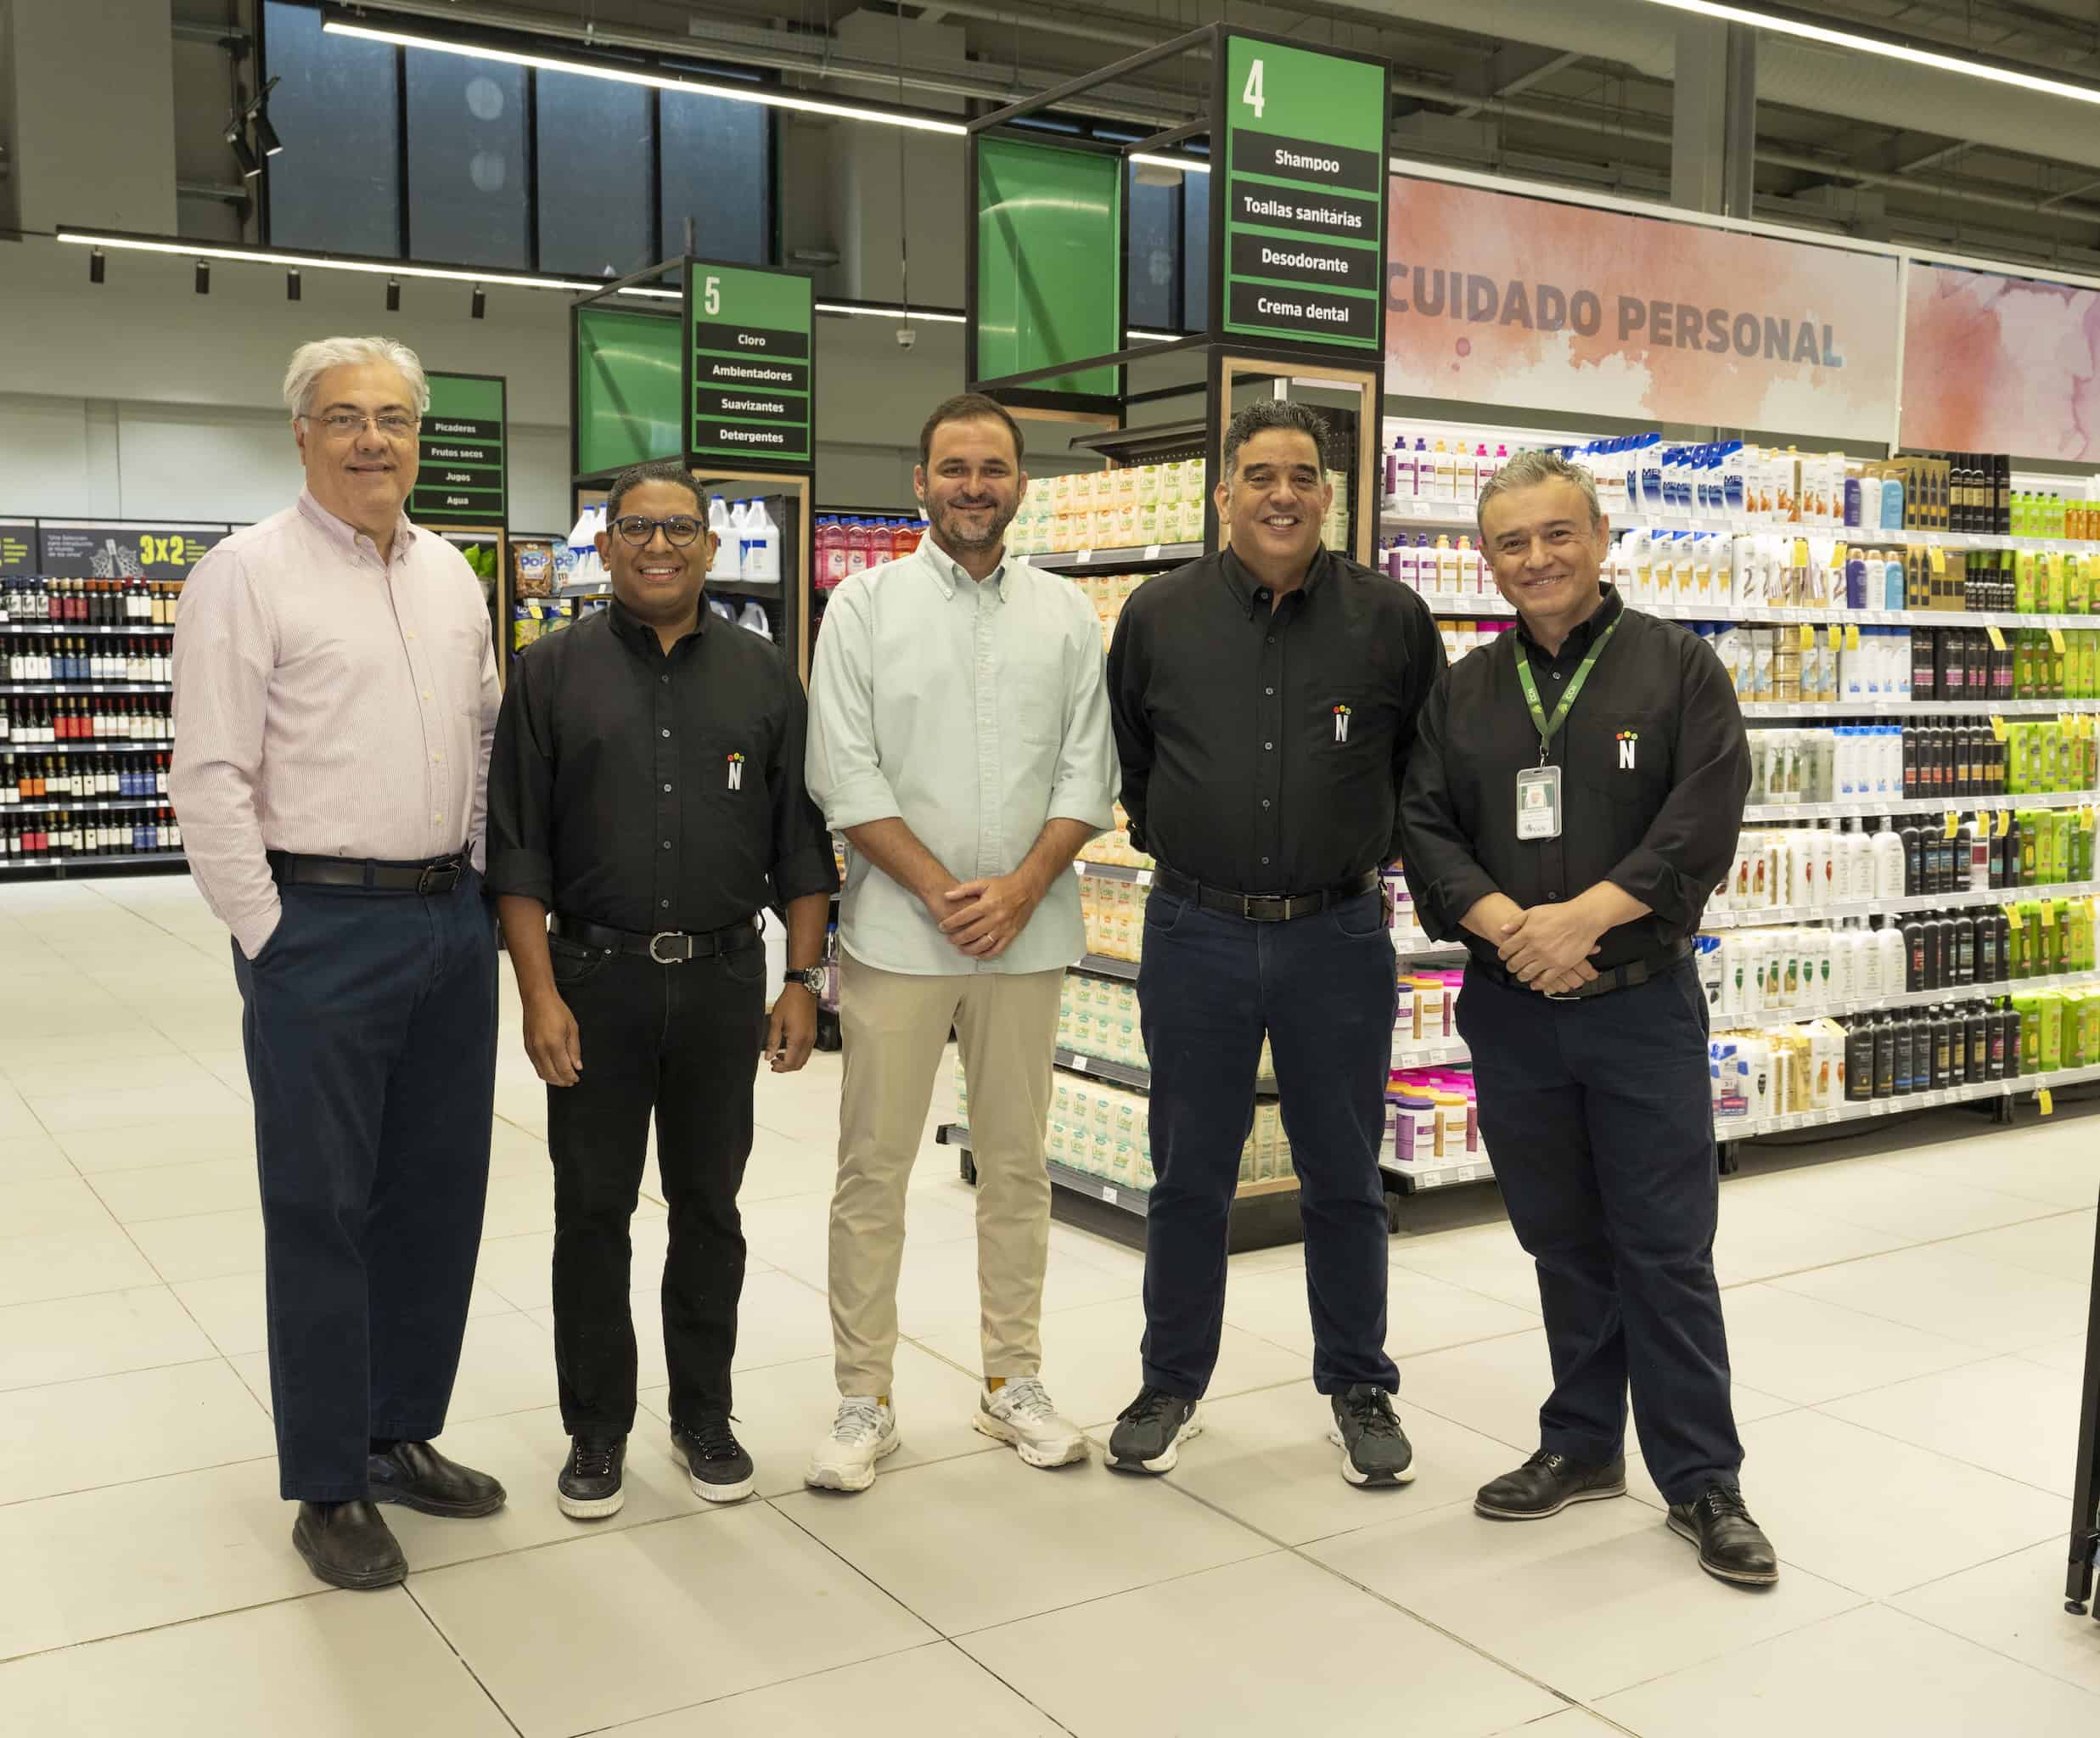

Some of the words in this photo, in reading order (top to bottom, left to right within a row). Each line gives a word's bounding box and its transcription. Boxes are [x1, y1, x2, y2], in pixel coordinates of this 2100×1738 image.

[1243, 59, 1265, 118] 4
[1275, 149, 1339, 172] Shampoo
[1244, 196, 1293, 218] Toallas
[1261, 248, 1349, 273] Desodorante
[705, 276, 721, 315] 5
[1257, 297, 1303, 318] Crema
[1305, 303, 1350, 322] dental
[1386, 262, 1602, 336] CUIDADO
[1617, 295, 1842, 367] PERSONAL
[738, 335, 766, 346] Cloro
[712, 364, 793, 381] Ambientadores
[722, 398, 784, 413] Suavizantes
[720, 429, 783, 442] Detergentes
[431, 447, 458, 458] Frutos
[446, 473, 471, 482] Jugos
[446, 496, 469, 505] Agua
[140, 535, 184, 565] 3x2
[1335, 713, 1349, 742] N
[1620, 740, 1635, 769] N
[728, 762, 742, 790] N
